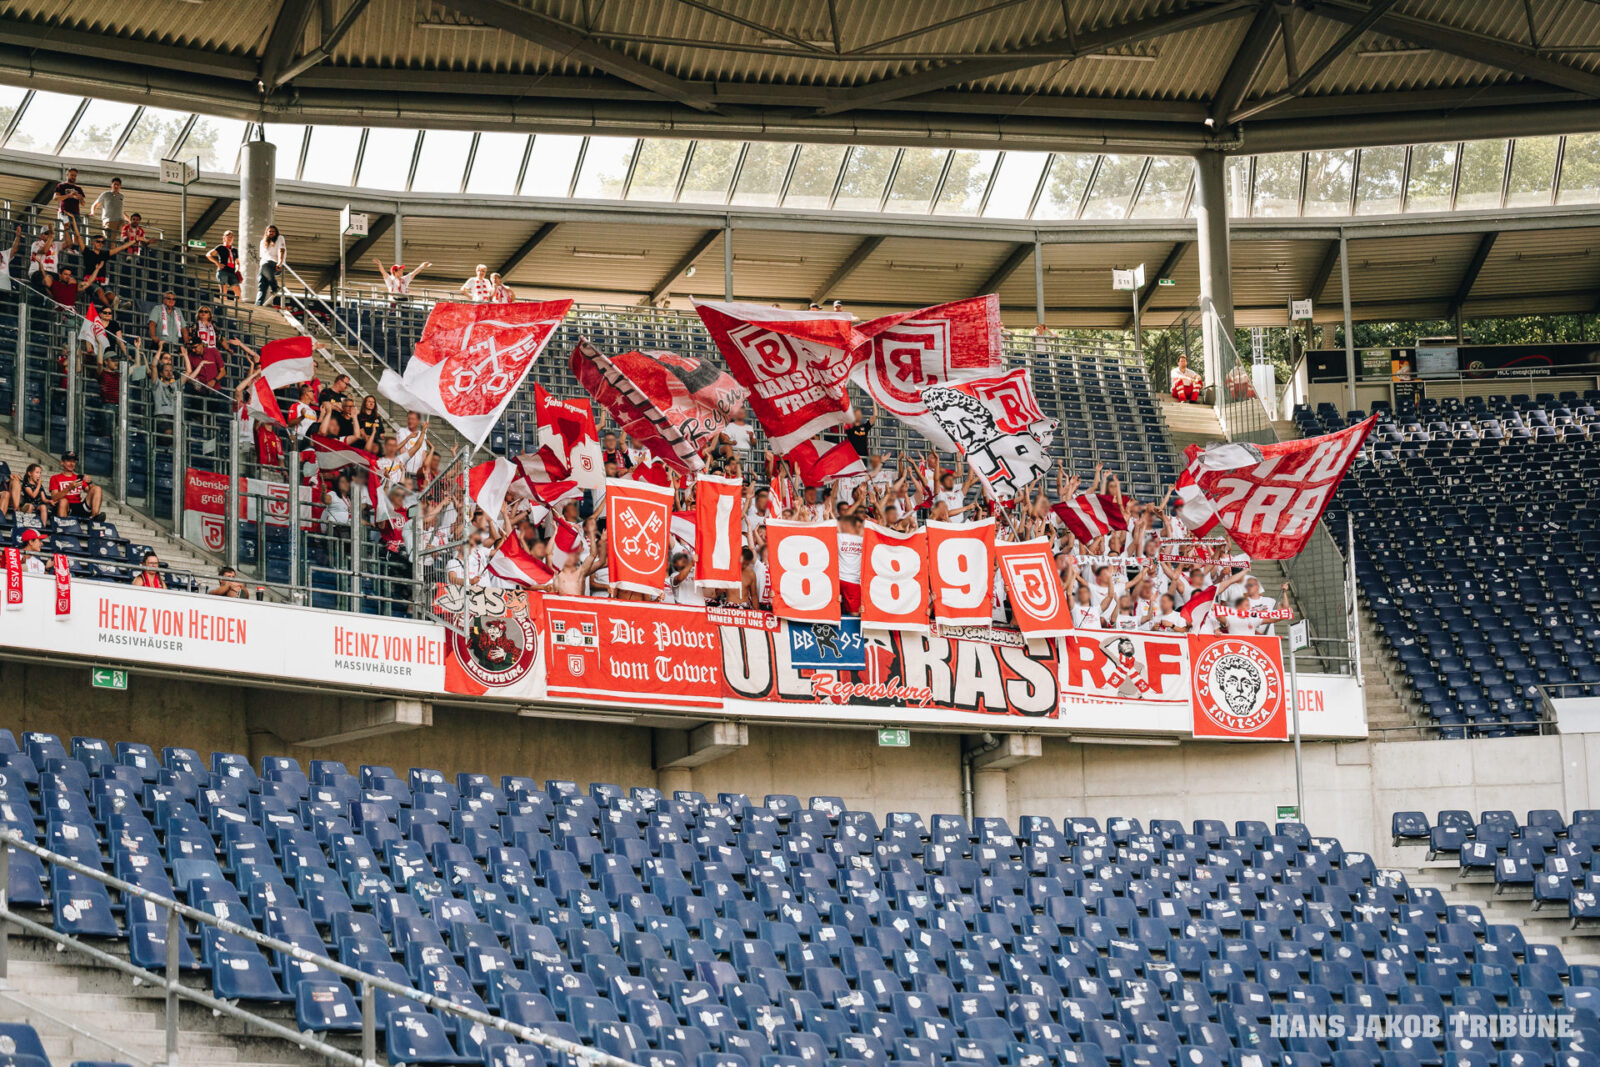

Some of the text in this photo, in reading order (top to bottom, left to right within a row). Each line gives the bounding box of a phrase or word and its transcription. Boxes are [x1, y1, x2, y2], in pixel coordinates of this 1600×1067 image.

[544, 395, 563, 409] Jahn
[774, 379, 847, 416] TRIB
[8, 548, 20, 588] SSV JAHN
[778, 534, 833, 611] 8
[869, 543, 922, 615] 8
[937, 537, 990, 609] 9
[98, 598, 247, 645] HEINZ VON HEIDEN
[706, 606, 763, 619] CHRISTOPH FÜR
[707, 614, 764, 628] IMMER BEI UNS
[98, 633, 183, 651] MASSIVHÄUSER
[334, 626, 447, 666] HEINZ VON HEI
[608, 617, 715, 651] Die Power
[792, 629, 814, 650] BB
[942, 625, 965, 637] RED
[334, 659, 412, 676] MASSIVHÄUSER
[467, 659, 524, 683] REGENSBURG
[609, 655, 718, 685] vom Tower
[719, 625, 1059, 718] ULRAS
[1065, 635, 1182, 694] R F
[1199, 643, 1277, 700] CASTRA REGINA
[811, 672, 933, 708] Regensburg
[1209, 704, 1271, 729] INVICTA
